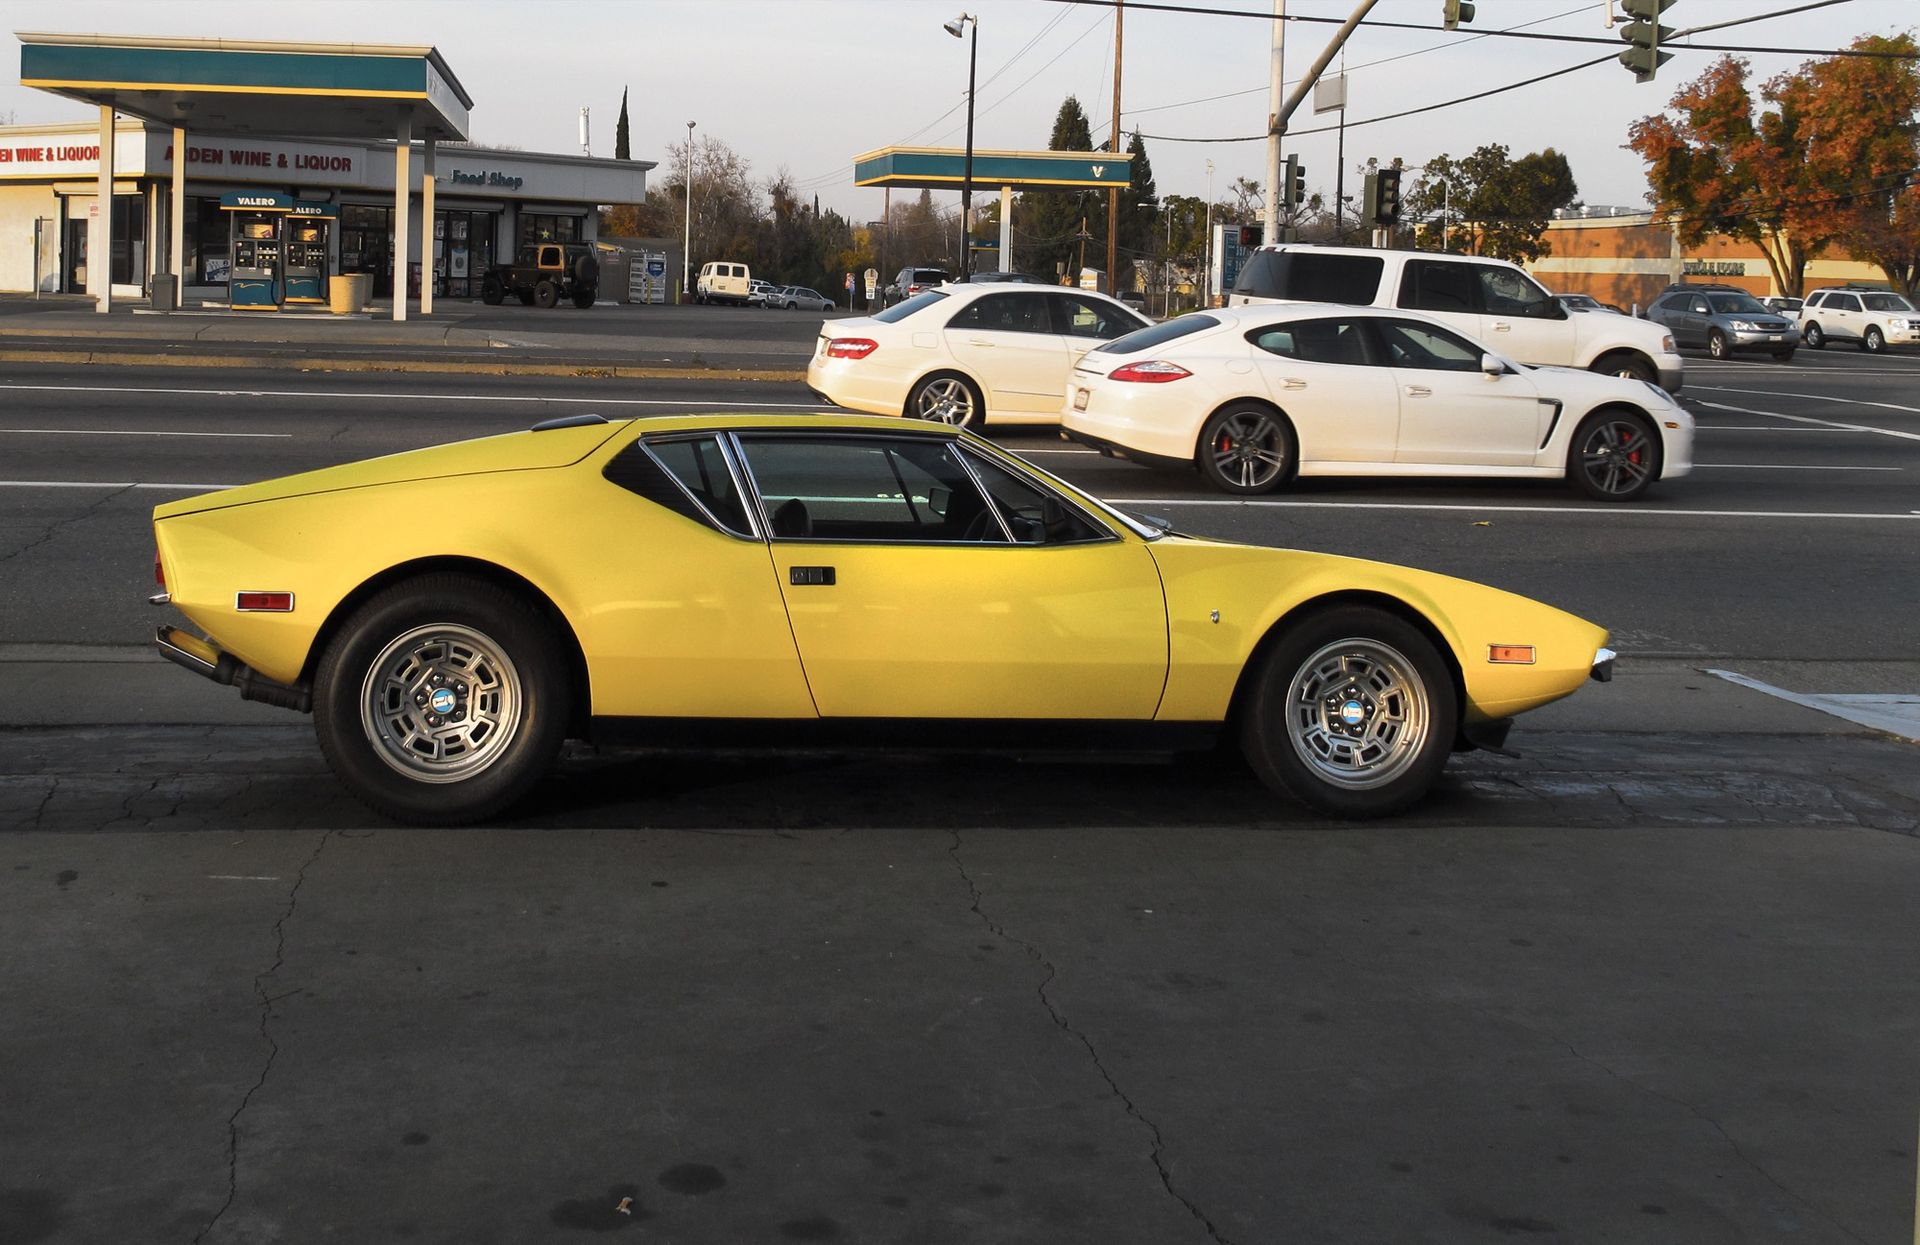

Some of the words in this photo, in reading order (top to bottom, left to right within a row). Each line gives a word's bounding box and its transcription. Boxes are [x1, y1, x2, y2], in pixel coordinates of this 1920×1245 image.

[16, 147, 44, 162] WINE
[46, 147, 54, 161] &
[57, 146, 100, 161] LIQUOR
[165, 145, 223, 164] ADEN
[230, 150, 272, 167] WINE
[277, 153, 288, 168] &
[295, 154, 352, 172] LIQUOR
[452, 169, 486, 185] Food
[487, 172, 523, 191] Shop
[237, 197, 276, 206] VALERO
